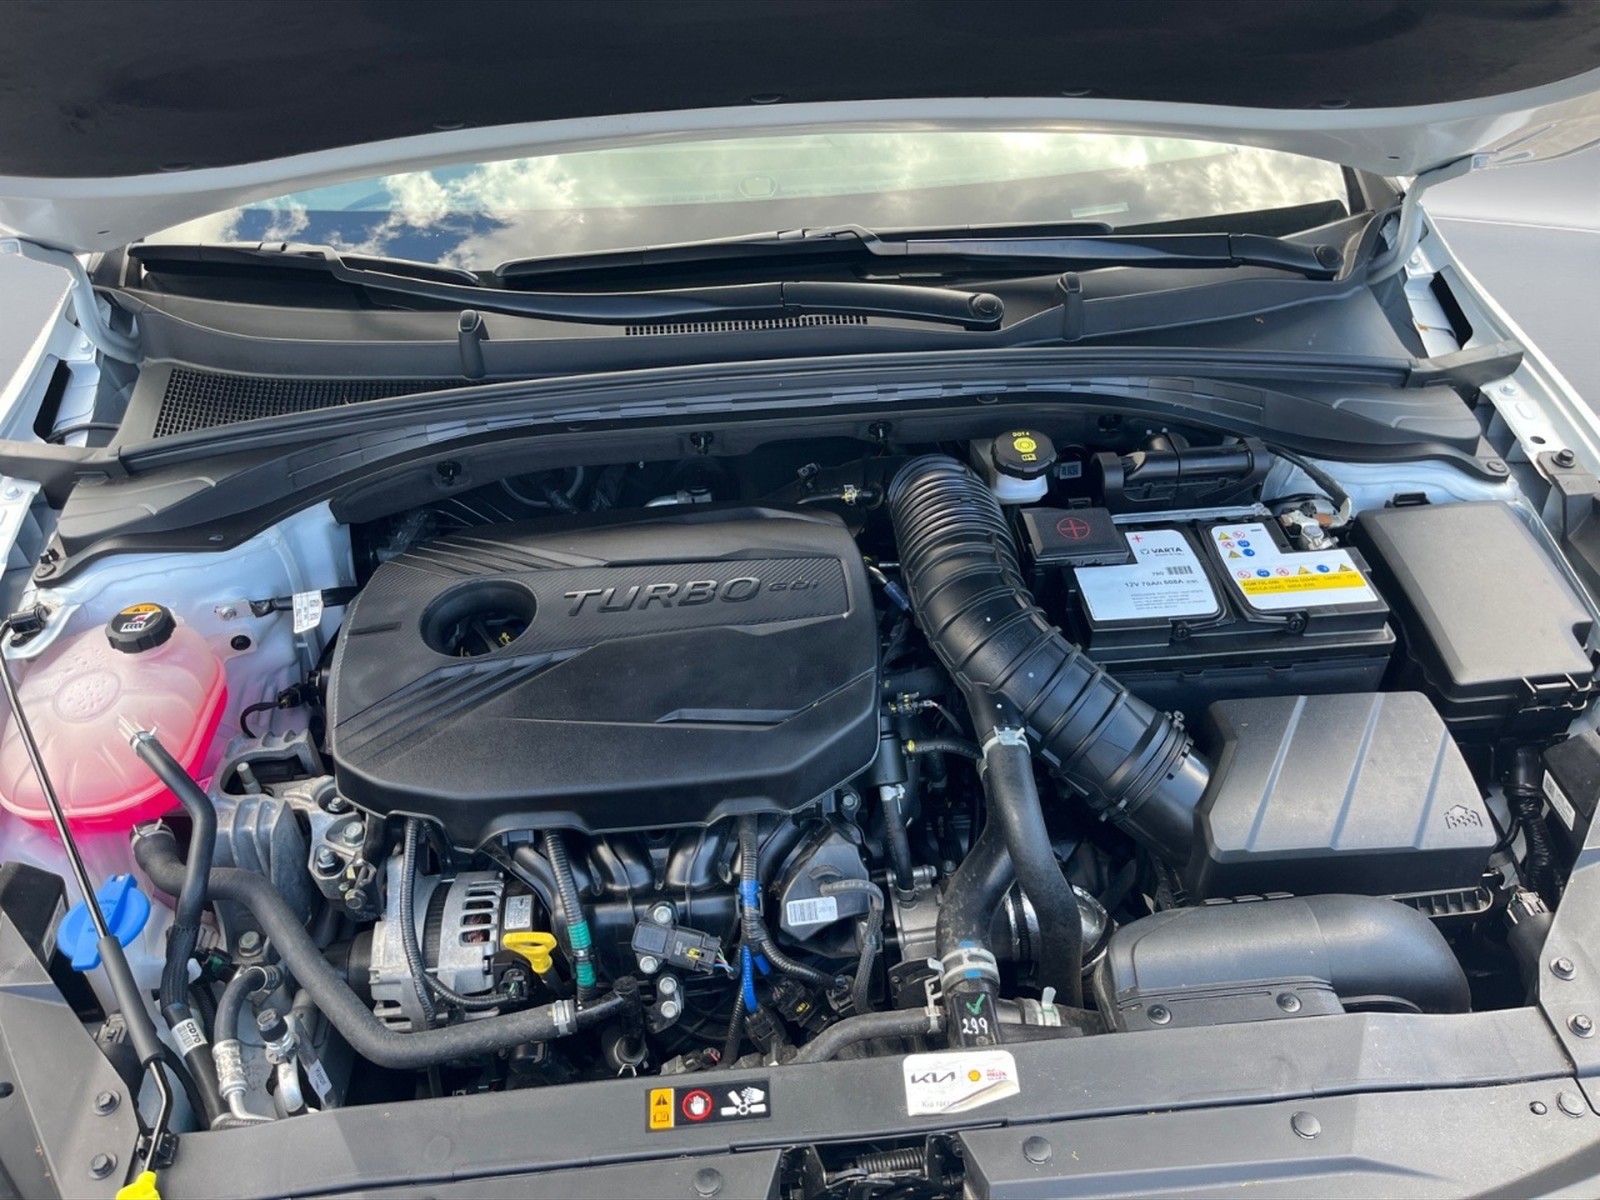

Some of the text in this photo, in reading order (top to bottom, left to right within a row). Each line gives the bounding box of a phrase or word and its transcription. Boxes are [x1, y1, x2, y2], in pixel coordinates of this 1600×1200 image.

[564, 576, 761, 617] TURBO
[186, 1022, 202, 1044] CD70
[962, 1018, 988, 1035] 299
